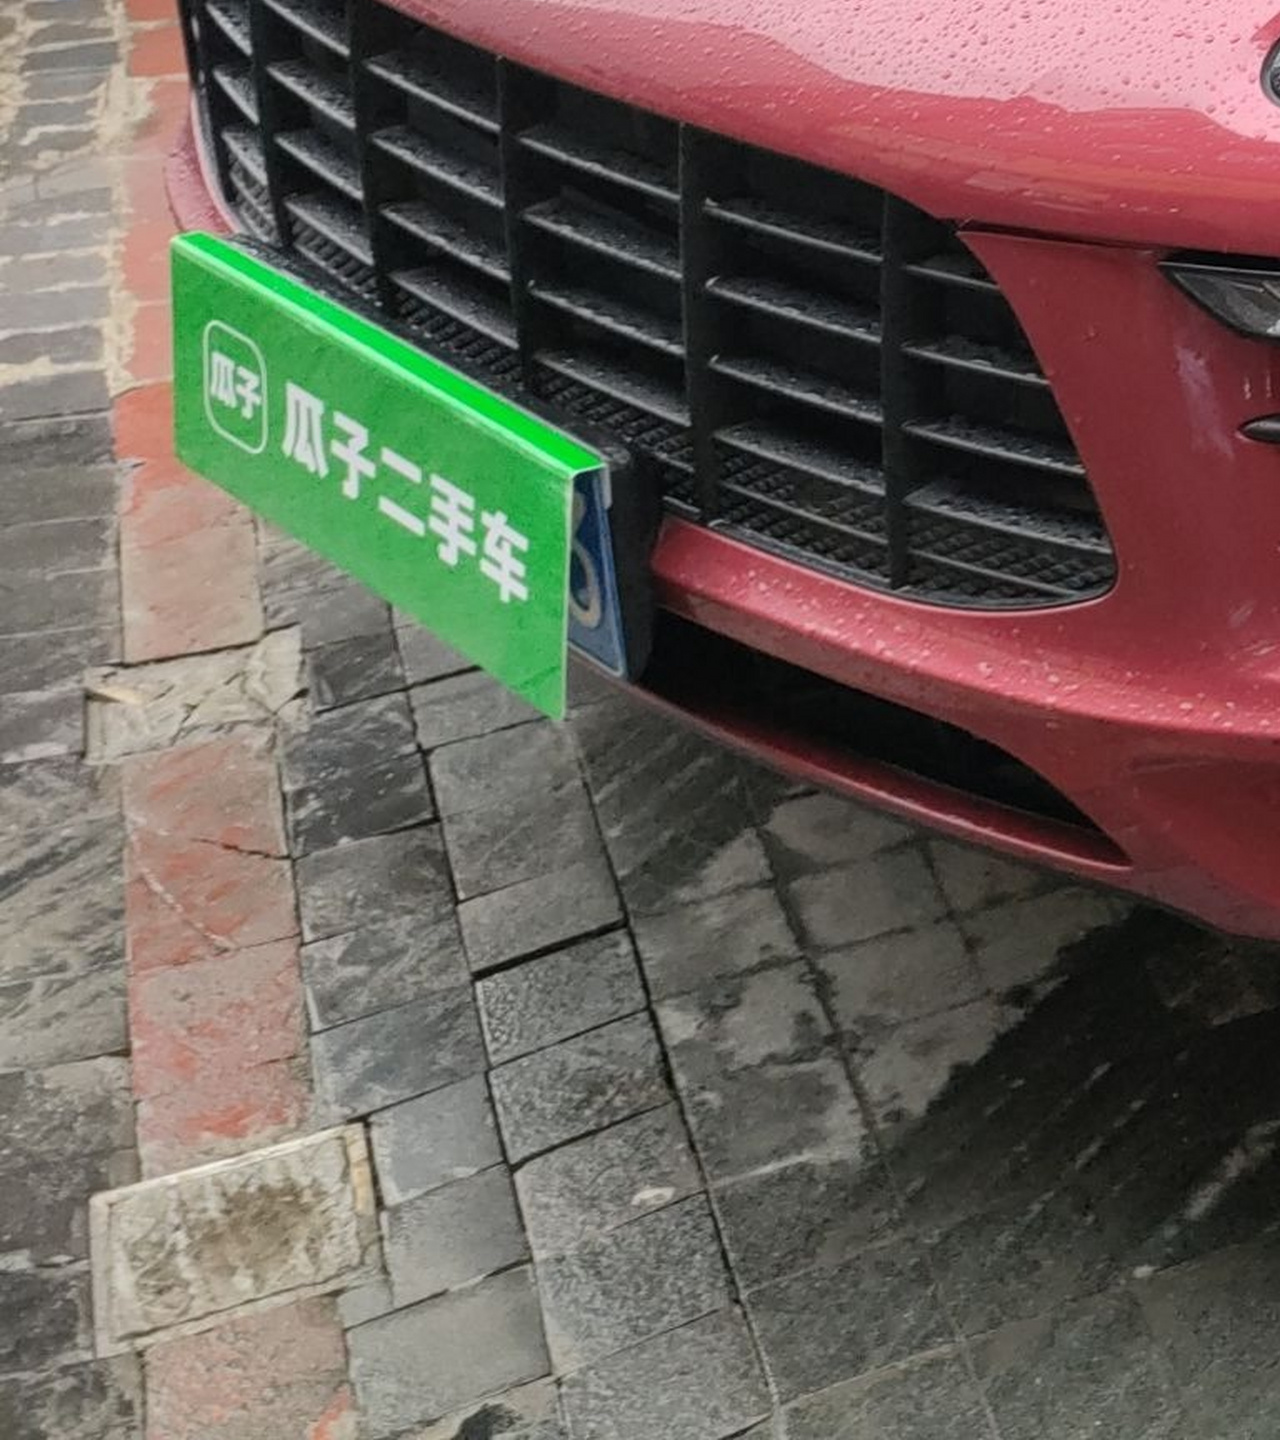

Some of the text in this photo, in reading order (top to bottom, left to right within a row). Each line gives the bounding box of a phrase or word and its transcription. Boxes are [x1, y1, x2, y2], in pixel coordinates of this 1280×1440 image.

[211, 351, 262, 420] 瓜子
[282, 381, 530, 604] 瓜子二手车
